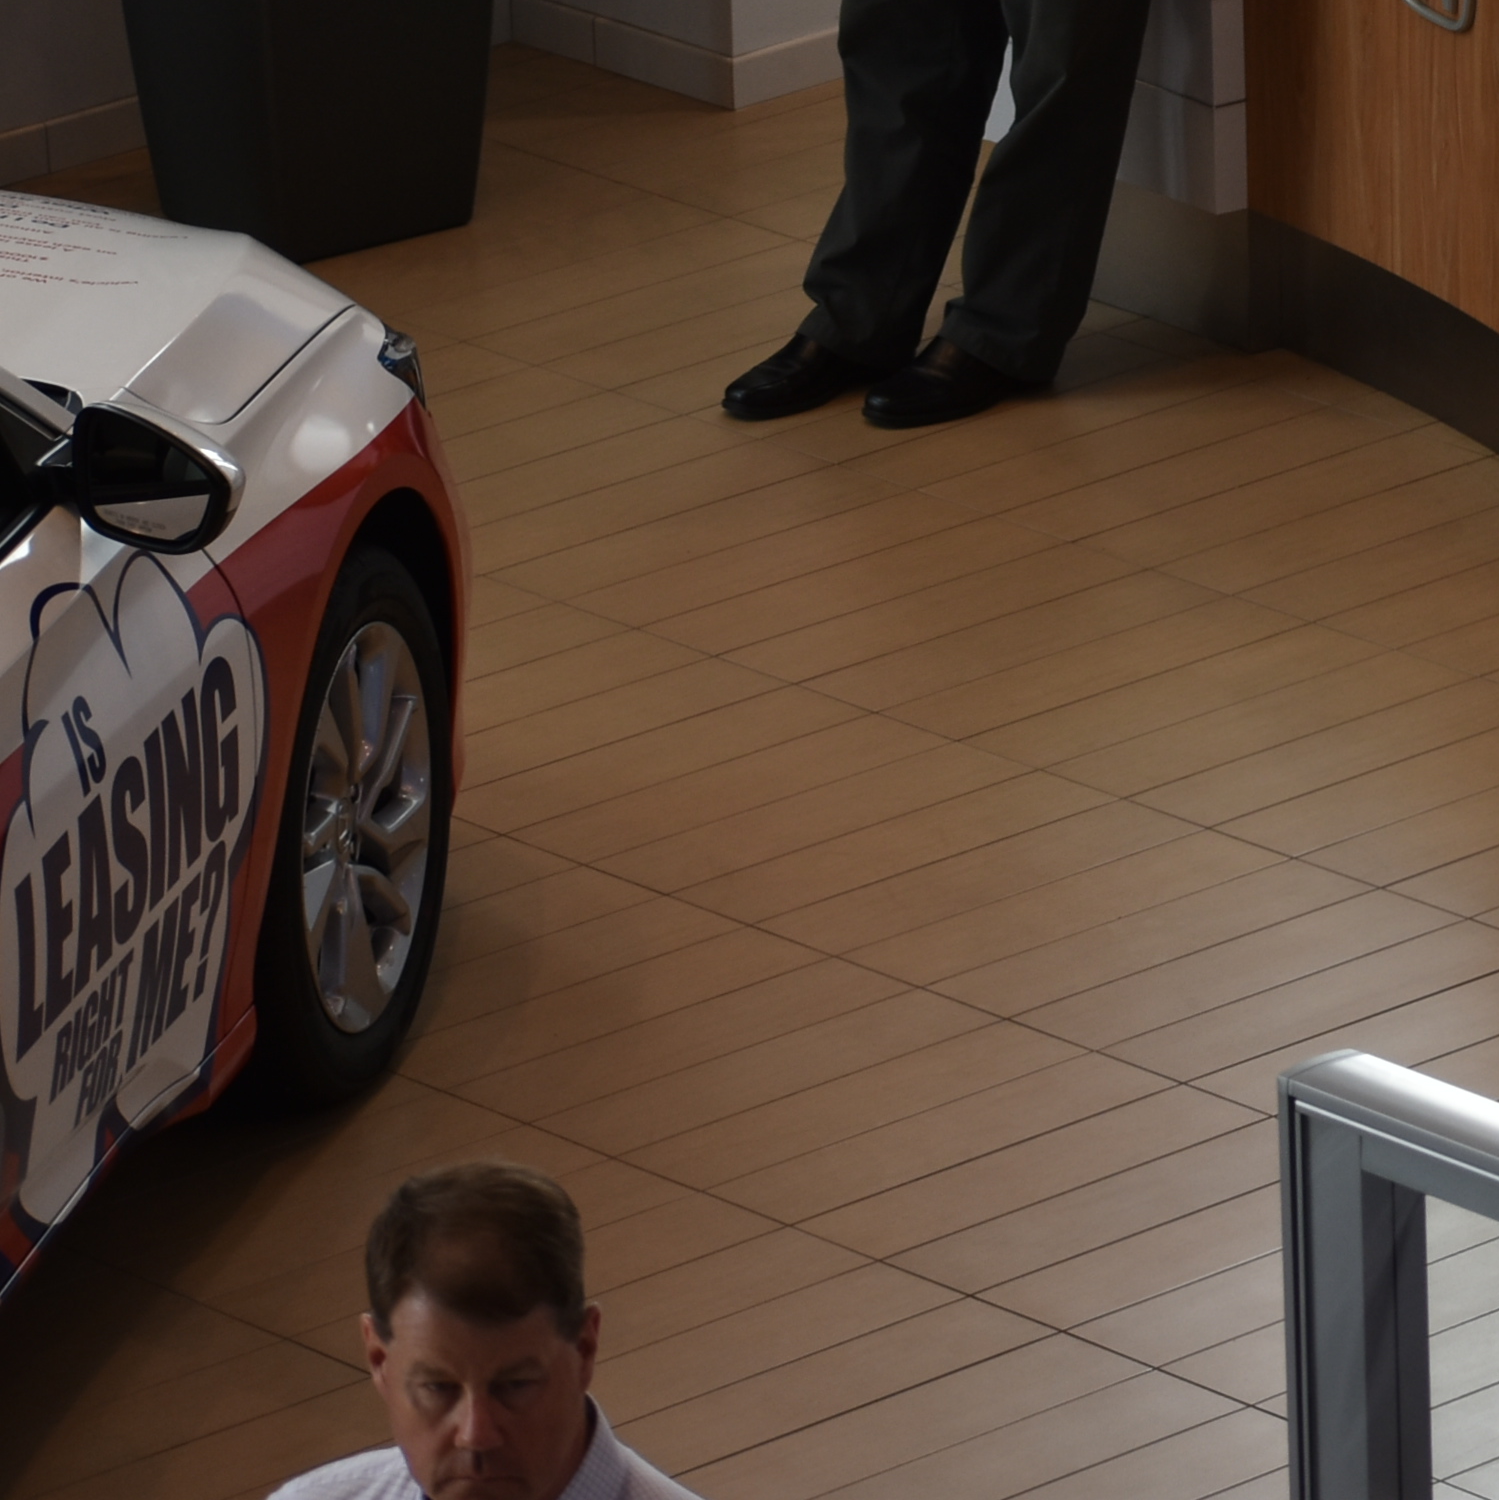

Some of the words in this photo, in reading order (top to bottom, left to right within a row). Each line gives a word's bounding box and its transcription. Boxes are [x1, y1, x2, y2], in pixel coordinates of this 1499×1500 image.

[60, 693, 107, 796] IS
[12, 655, 240, 1063] LEASING
[49, 947, 136, 1105] RIGHT
[126, 840, 226, 1066] ME?
[74, 1035, 124, 1134] FOR
